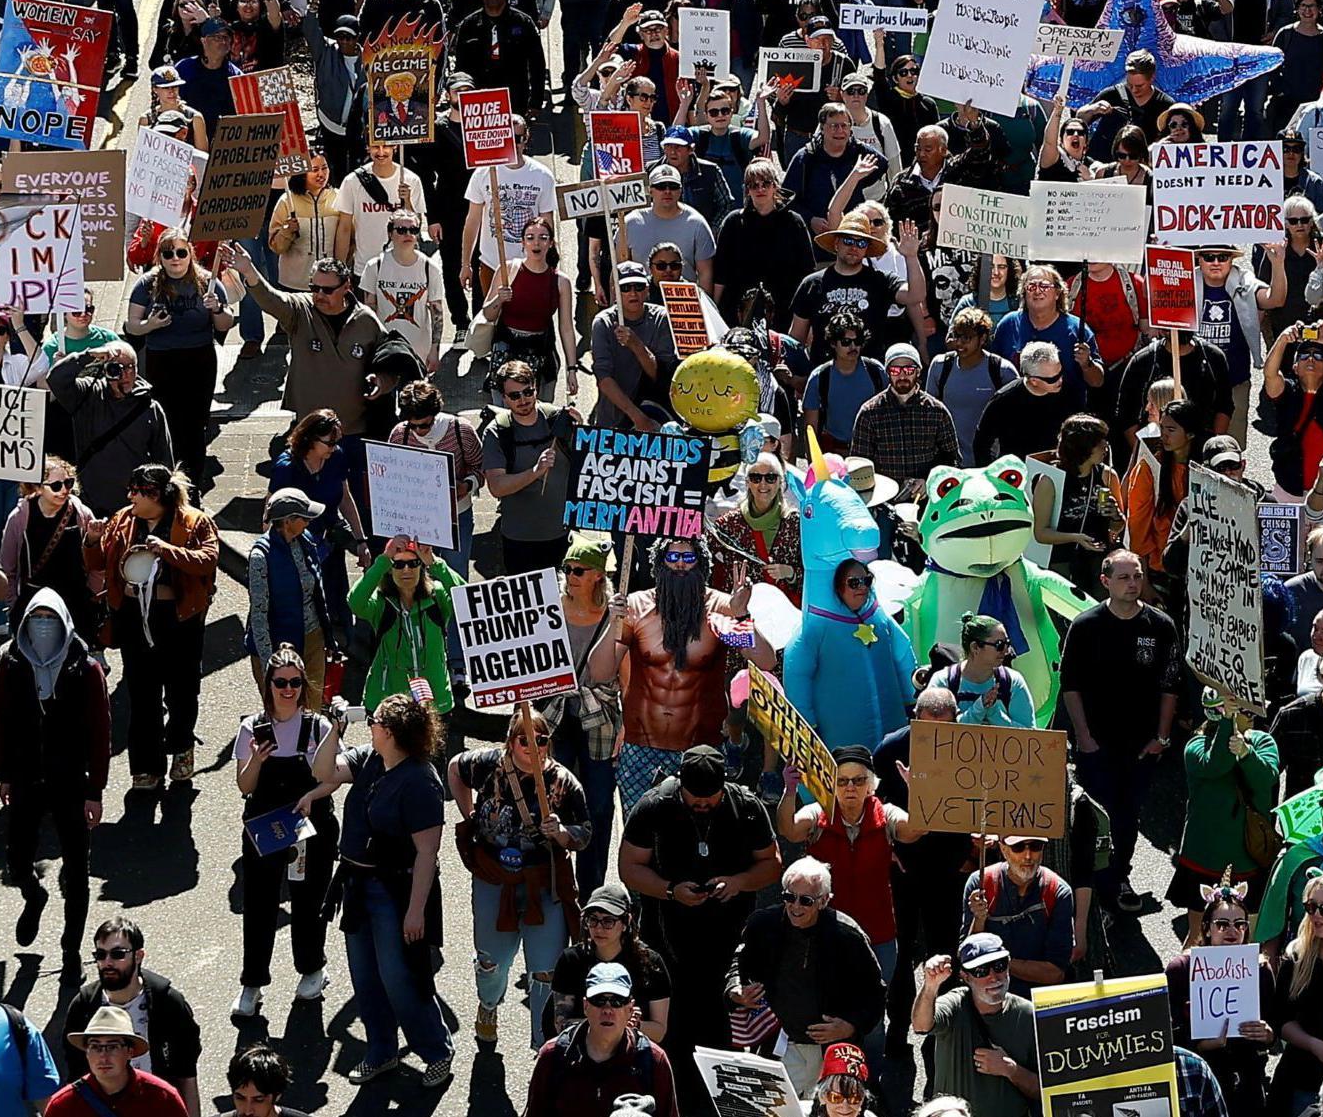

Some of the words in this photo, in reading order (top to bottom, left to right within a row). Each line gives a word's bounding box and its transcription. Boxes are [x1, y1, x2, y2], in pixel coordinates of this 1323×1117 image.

[374, 59, 427, 74] REGIME
[464, 104, 480, 117] NO
[481, 101, 501, 116] ICE
[465, 117, 482, 129] NO
[484, 114, 510, 128] WAR
[374, 124, 428, 139] CHANGE
[468, 131, 488, 141] TAKE
[489, 129, 510, 139] DOWN
[476, 139, 504, 148] TRUMP
[1156, 144, 1280, 170] AMERICA
[1156, 177, 1205, 189] DOESNT
[1216, 176, 1251, 188] NEED
[1258, 176, 1272, 188] A
[1157, 205, 1284, 231] DICK-TATOR
[576, 427, 704, 465] MERMAIDS
[582, 452, 688, 484] AGAINST
[577, 476, 676, 506] FASCISM
[683, 489, 702, 506] =
[564, 502, 702, 537] MERMANTIFA
[467, 573, 547, 619] FIGHT
[469, 643, 571, 685] AGENDA
[934, 729, 1044, 766] HONOR
[954, 767, 1022, 793] OUR
[918, 797, 1054, 830] VETERANS
[1192, 956, 1252, 981] Abolish
[1200, 986, 1240, 1020] ICE
[1066, 1007, 1141, 1034] Fascism
[1046, 1030, 1165, 1073] DUMMIES
